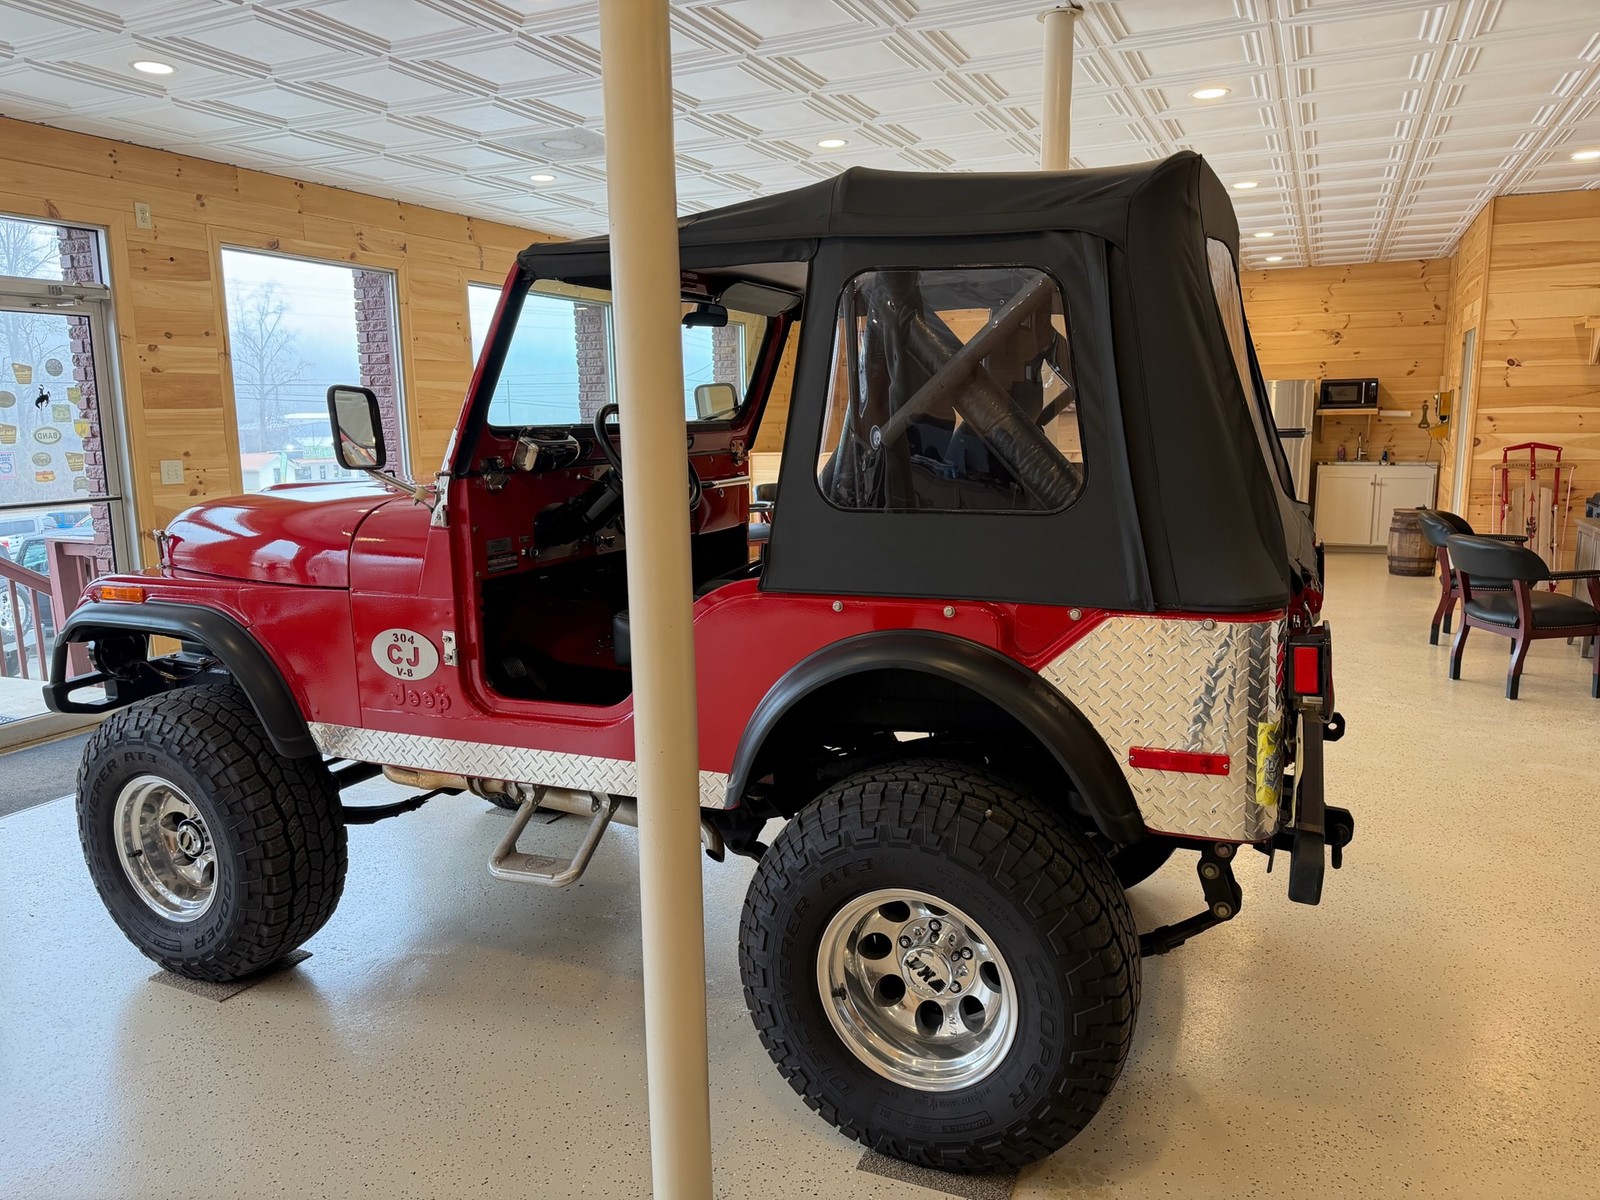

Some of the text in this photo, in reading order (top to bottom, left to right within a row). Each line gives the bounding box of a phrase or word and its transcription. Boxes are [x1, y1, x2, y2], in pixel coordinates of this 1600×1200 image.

[392, 633, 415, 645] 304
[387, 643, 420, 667] CJ
[396, 666, 414, 678] V-8
[390, 682, 452, 714] Jeep
[124, 751, 157, 763] AT3
[194, 863, 231, 950] COOPER
[780, 857, 873, 1096] DISCOVERER AT3
[1009, 954, 1056, 1110] COOPER
